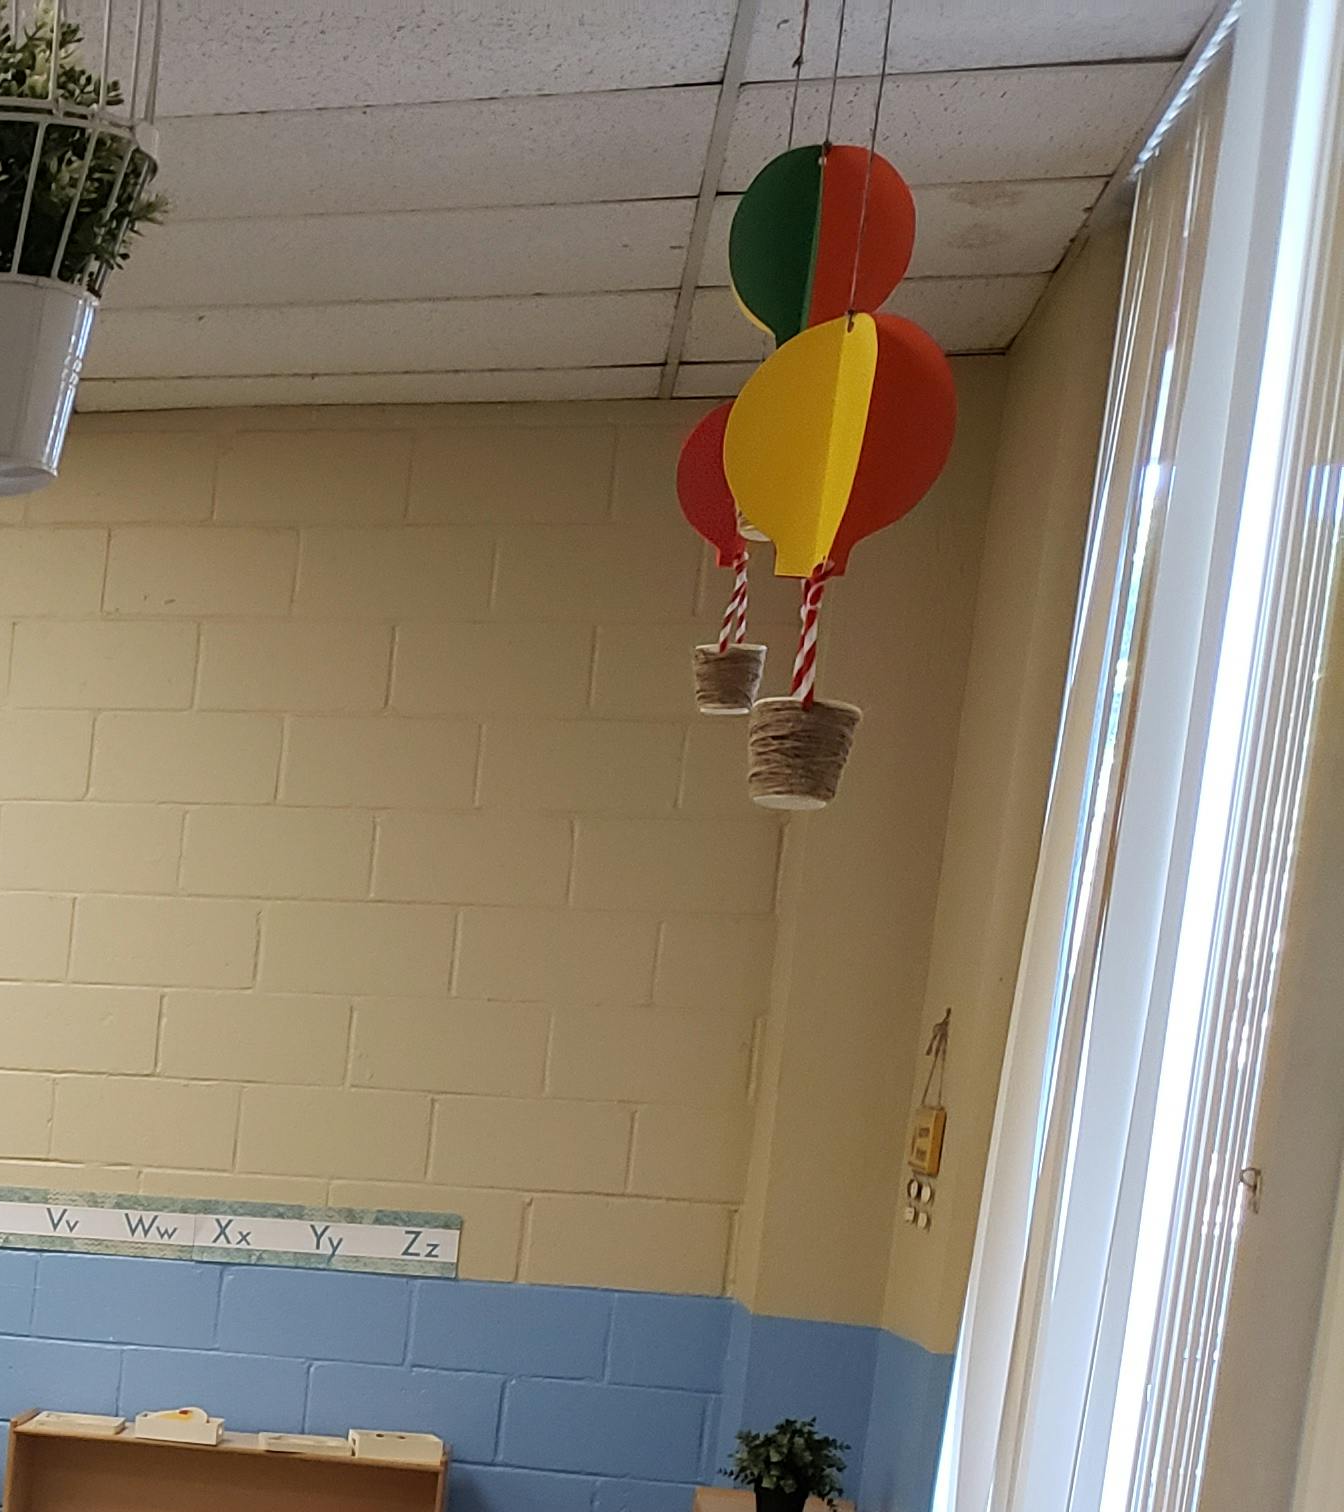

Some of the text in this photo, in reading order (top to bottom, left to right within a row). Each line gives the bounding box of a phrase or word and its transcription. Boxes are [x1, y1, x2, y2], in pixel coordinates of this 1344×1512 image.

[46, 1207, 80, 1233] Vv
[124, 1213, 178, 1240] Ww
[211, 1218, 252, 1246] Xx
[309, 1225, 343, 1257] Yy
[400, 1231, 440, 1259] Zz
